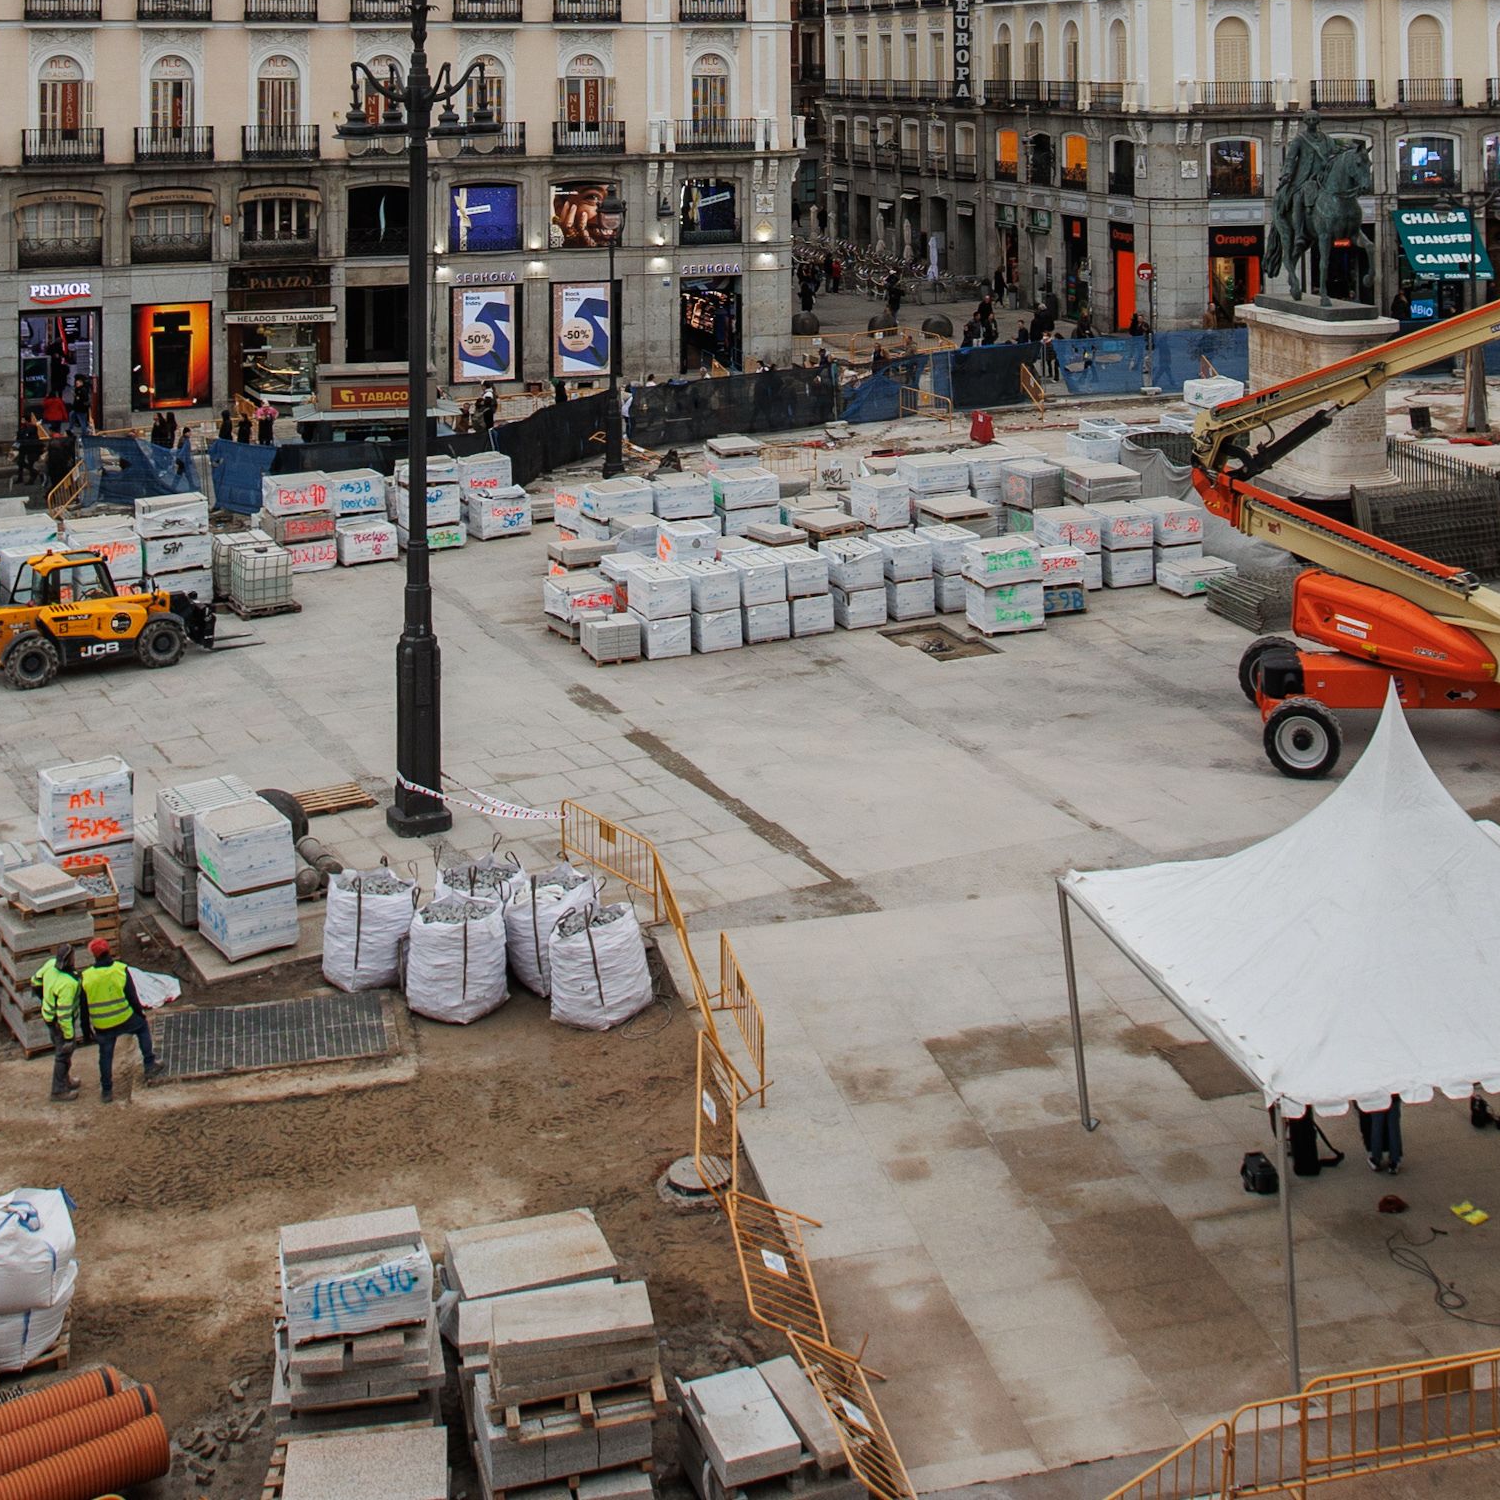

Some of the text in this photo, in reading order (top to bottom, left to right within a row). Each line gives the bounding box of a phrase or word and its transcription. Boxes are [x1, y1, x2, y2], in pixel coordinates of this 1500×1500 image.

[1215, 234, 1258, 246] Orange
[1415, 253, 1482, 265] CAMBIO
[682, 263, 741, 275] SEPHORA
[250, 276, 313, 289] PALAZZO
[455, 272, 517, 283] SEPHORA
[30, 283, 91, 297] PRIMOR
[237, 314, 325, 323] HELADOS ITALIANOS
[81, 642, 120, 657] JCB
